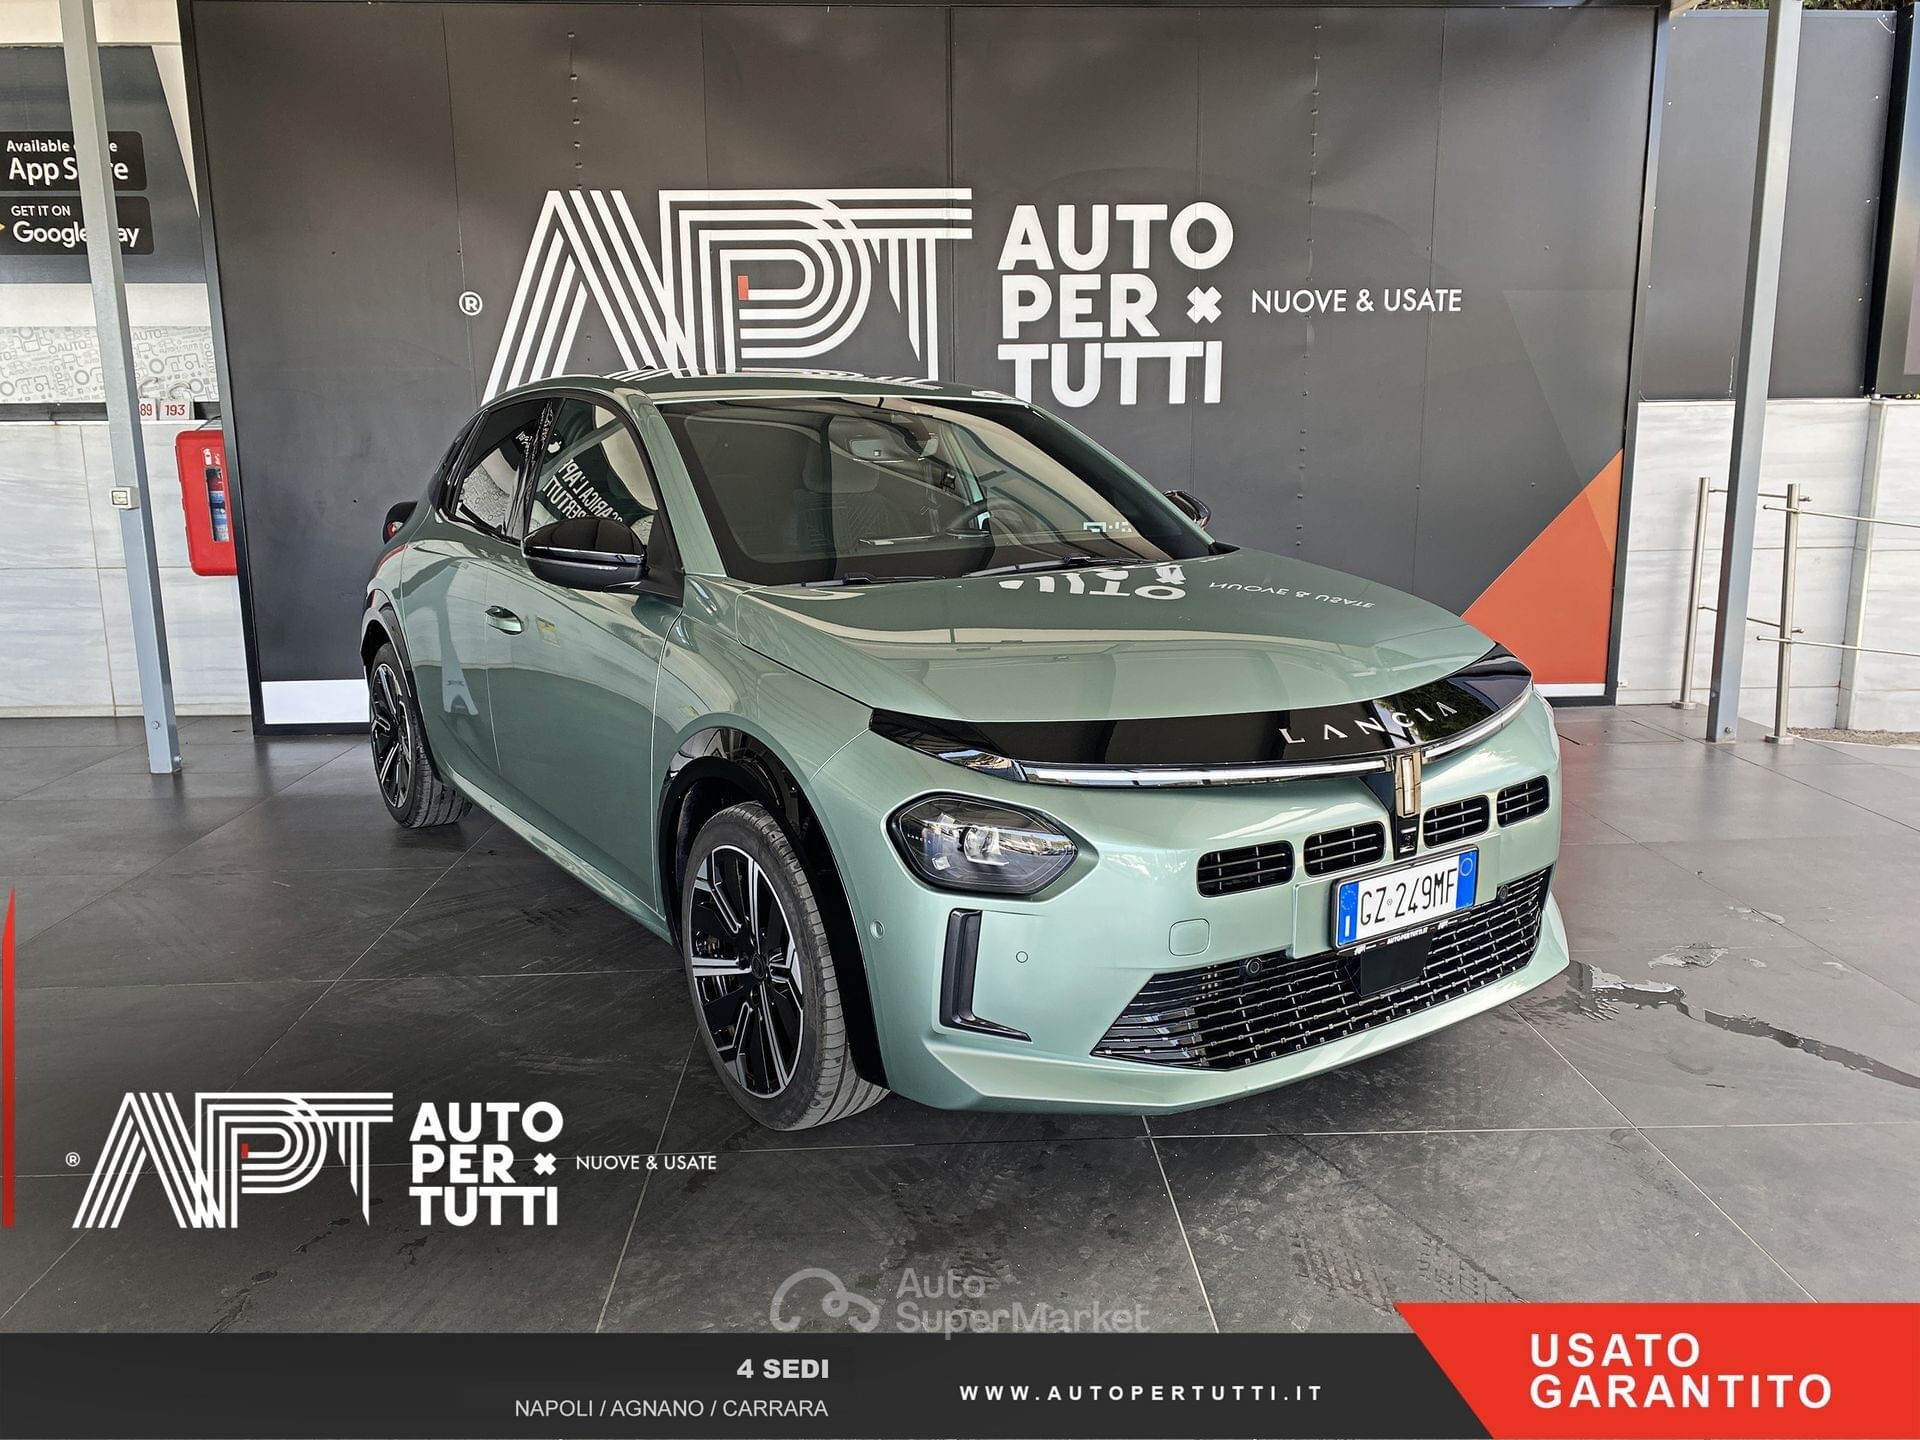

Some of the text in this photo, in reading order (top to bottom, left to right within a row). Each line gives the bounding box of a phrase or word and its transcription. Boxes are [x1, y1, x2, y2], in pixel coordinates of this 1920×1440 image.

[6, 139, 70, 153] Available
[9, 157, 60, 186] App
[11, 205, 71, 217] GET IT ON
[13, 220, 87, 249] Google
[997, 202, 1234, 271] AUTO
[1002, 273, 1161, 339] PER
[1251, 287, 1464, 314] NUOVE & USATE
[997, 340, 1223, 408] TUTTI
[165, 404, 185, 416] 193
[1278, 700, 1458, 745] LANCIA
[1360, 867, 1458, 926] GZ 249MF
